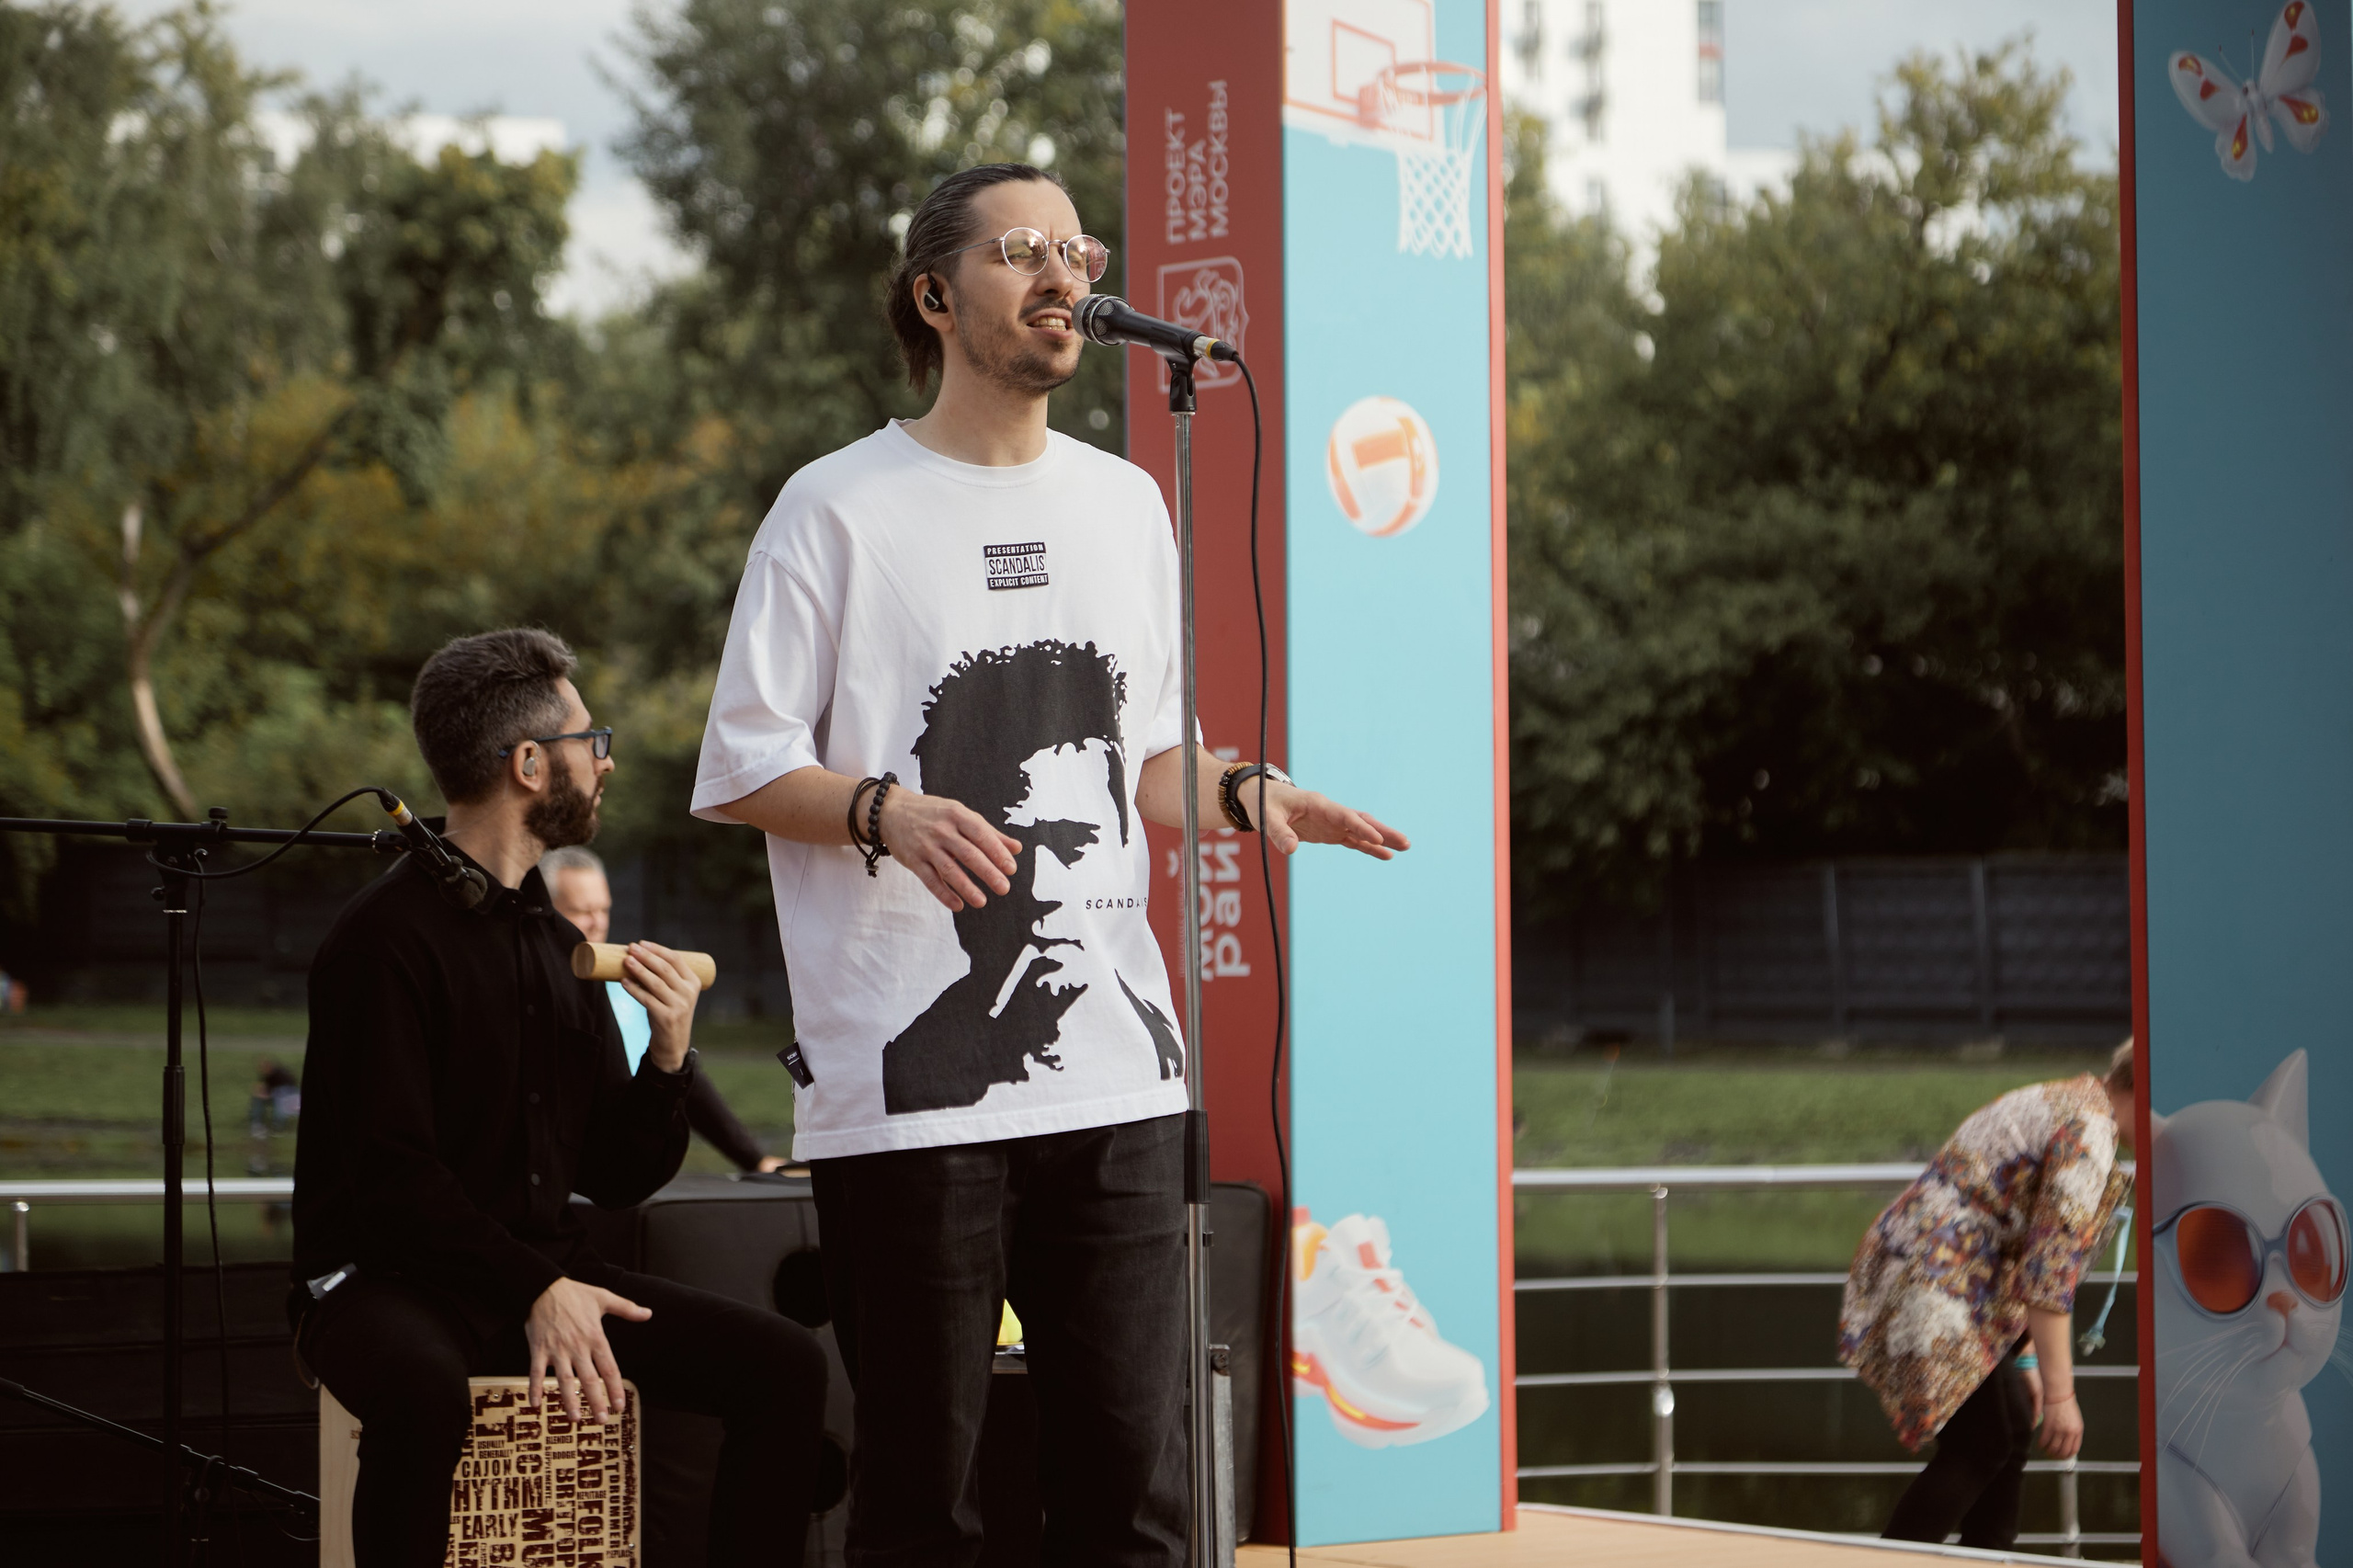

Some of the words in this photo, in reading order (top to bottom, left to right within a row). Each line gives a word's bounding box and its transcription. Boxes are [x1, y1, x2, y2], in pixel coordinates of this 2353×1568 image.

[1165, 107, 1186, 245] ПРОЕКТ
[1208, 79, 1229, 238] МОСКВЫ
[1187, 139, 1208, 242] МЭРА
[987, 544, 1043, 555] PRESENTATION
[988, 554, 1045, 575] SCANDALIS
[990, 578, 1018, 587] EXPLICIT
[1020, 574, 1048, 585] CONTENT
[516, 1392, 542, 1474] TRIC
[461, 1459, 512, 1478] CAJON
[454, 1476, 543, 1512] HYTHM
[609, 1474, 620, 1549] DRUMMER
[462, 1513, 519, 1540] EARLY
